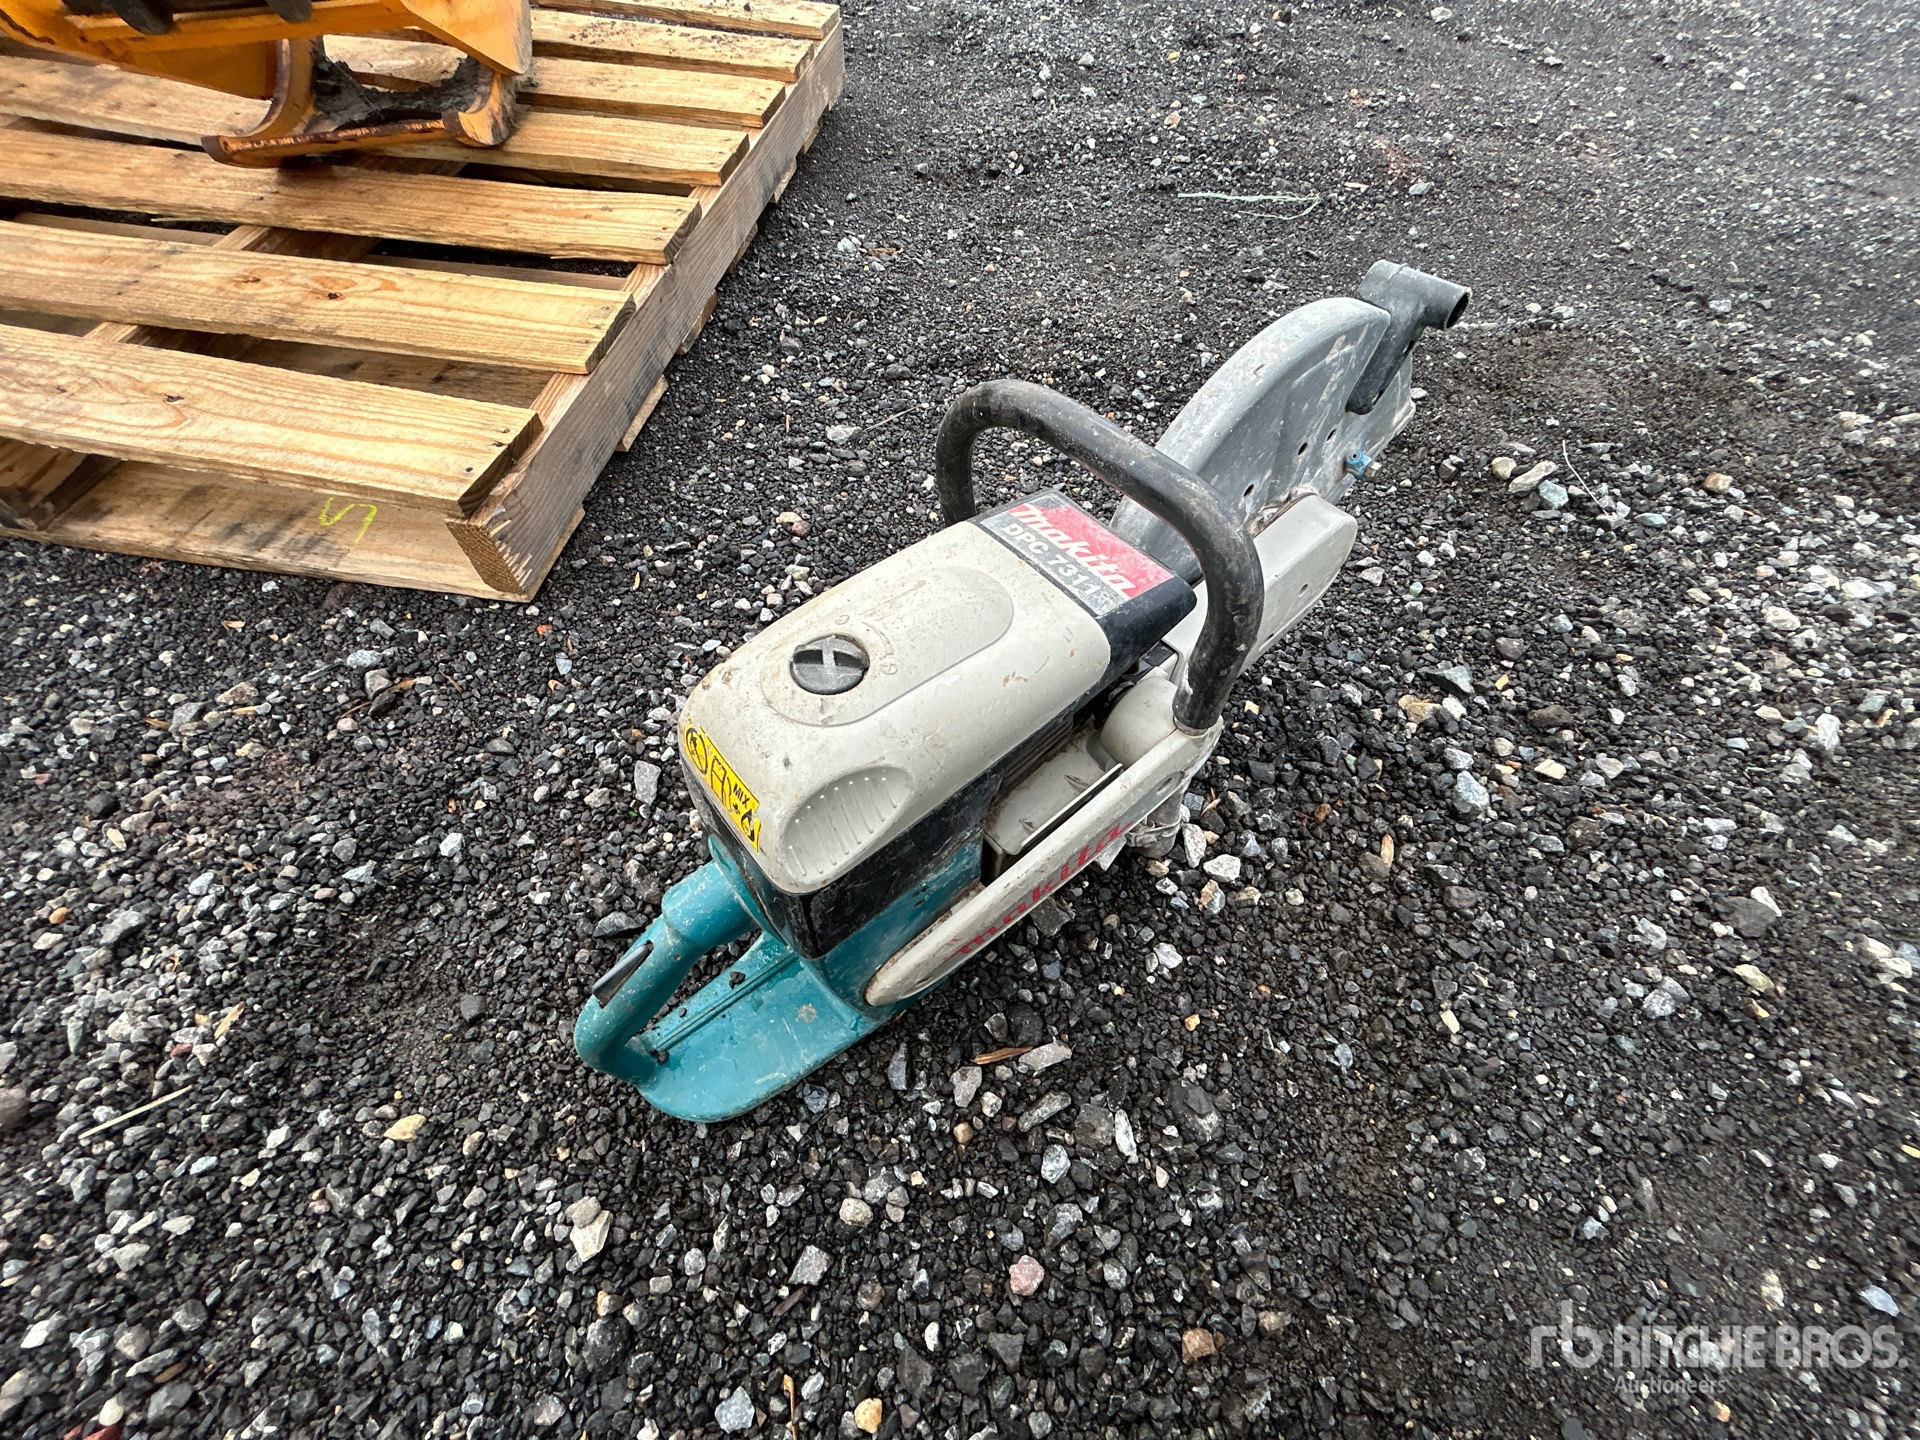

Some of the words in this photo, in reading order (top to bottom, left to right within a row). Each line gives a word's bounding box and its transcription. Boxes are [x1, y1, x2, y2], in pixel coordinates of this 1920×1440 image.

[1001, 522, 1049, 555] DPC
[1046, 553, 1102, 596] 7311
[1010, 502, 1136, 600] makita
[733, 782, 750, 809] MIX
[943, 820, 1133, 963] makita
